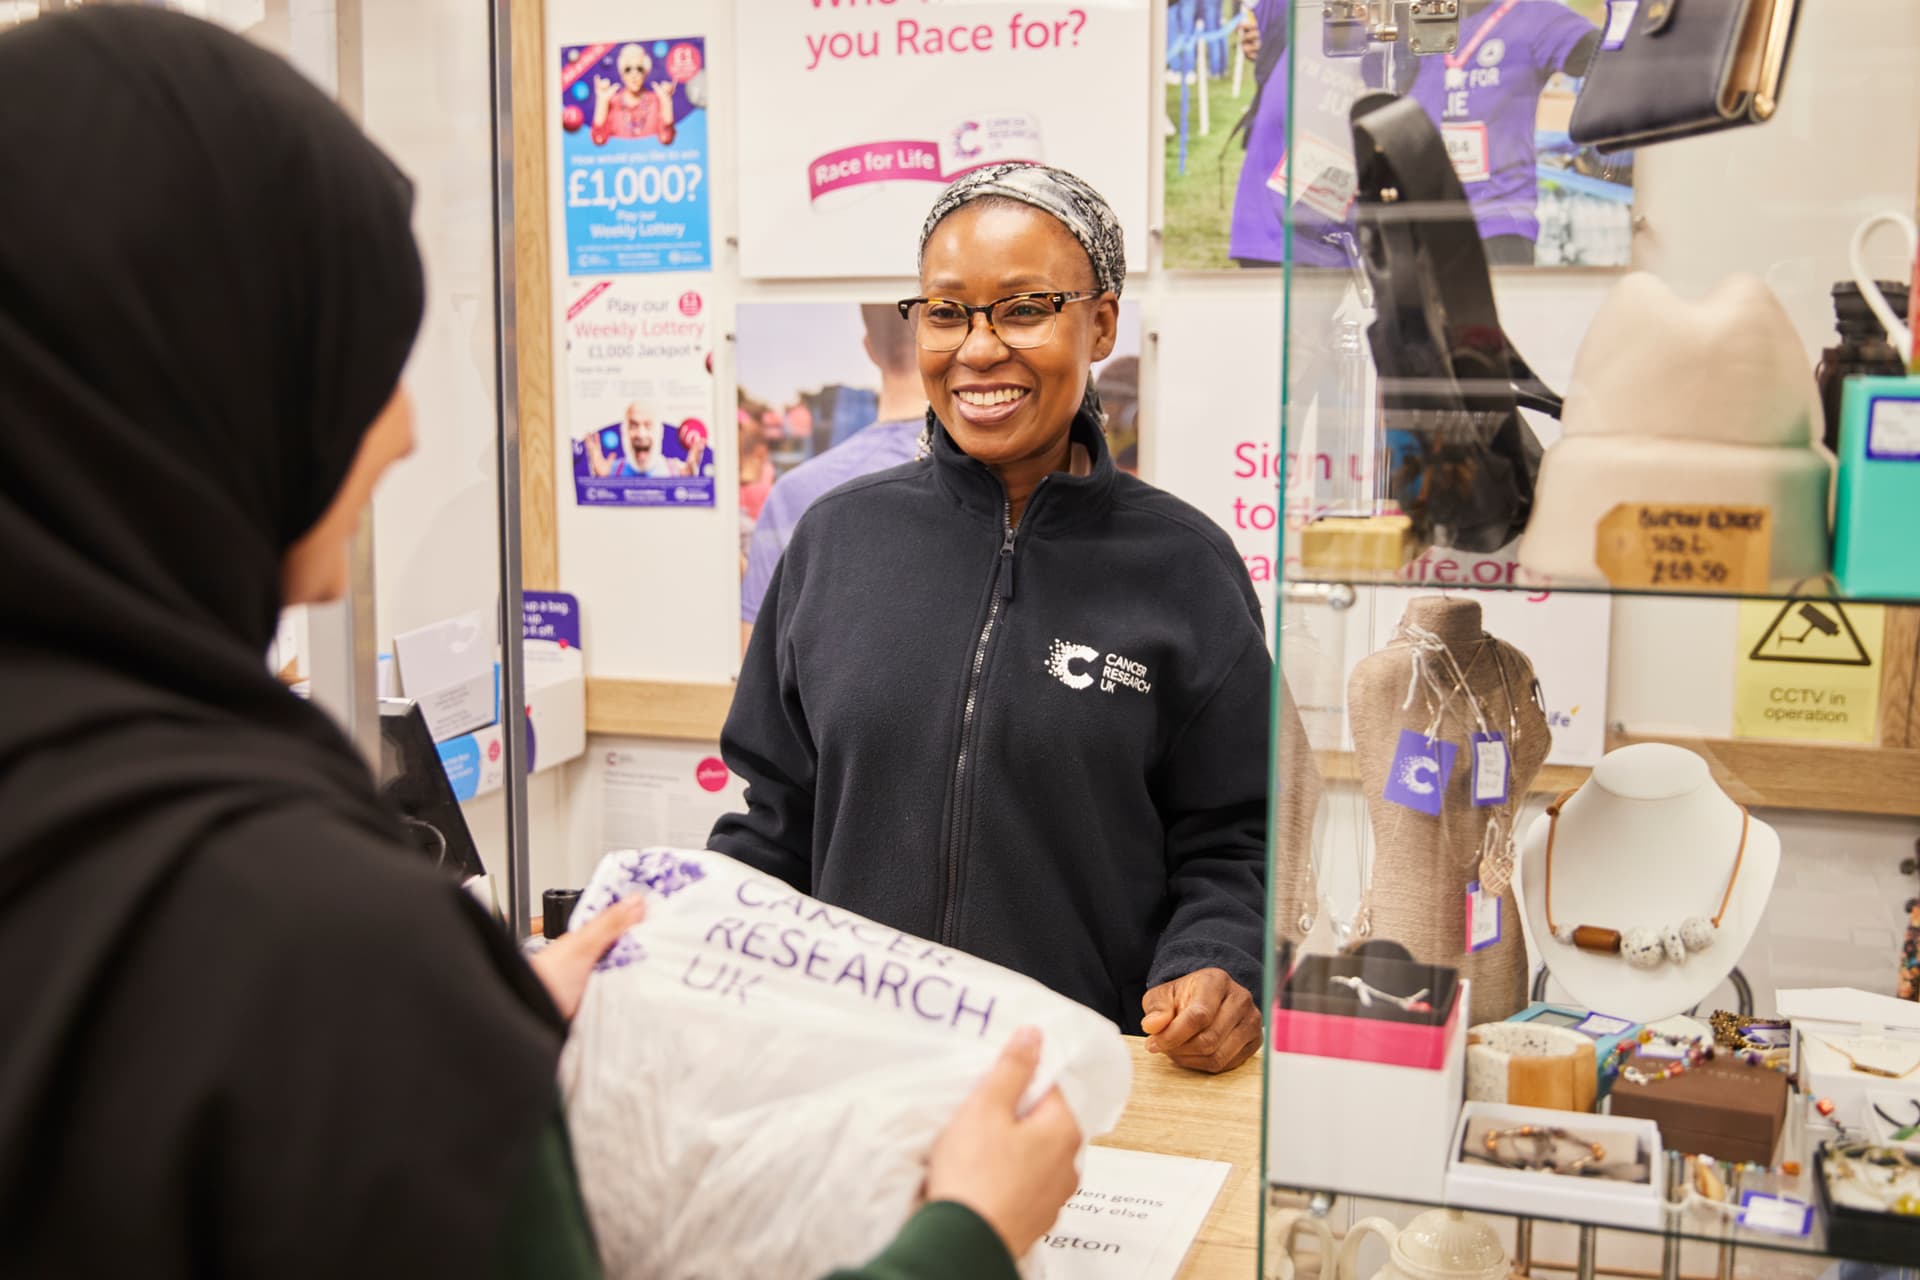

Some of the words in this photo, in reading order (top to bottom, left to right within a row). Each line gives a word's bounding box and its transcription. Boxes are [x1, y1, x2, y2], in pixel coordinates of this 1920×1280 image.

[805, 30, 879, 70] you
[896, 18, 993, 56] Race
[1009, 9, 1088, 49] for?
[815, 158, 861, 187] Race
[864, 149, 893, 172] for
[897, 148, 936, 171] Life
[568, 163, 703, 211] £1,000?
[607, 297, 638, 316] Play
[643, 299, 669, 313] our
[575, 320, 636, 341] Weekly
[642, 319, 706, 341] Lottery
[1105, 653, 1148, 678] CANCER
[1100, 678, 1117, 694] UK
[1102, 665, 1152, 694] RESEARCH
[1769, 687, 1825, 704] CCTV
[1829, 691, 1847, 705] in
[1763, 706, 1849, 724] operation
[682, 955, 764, 1004] UK
[705, 916, 997, 1037] RESEARCH
[1110, 1194, 1165, 1208] gems
[1109, 1208, 1149, 1220] else
